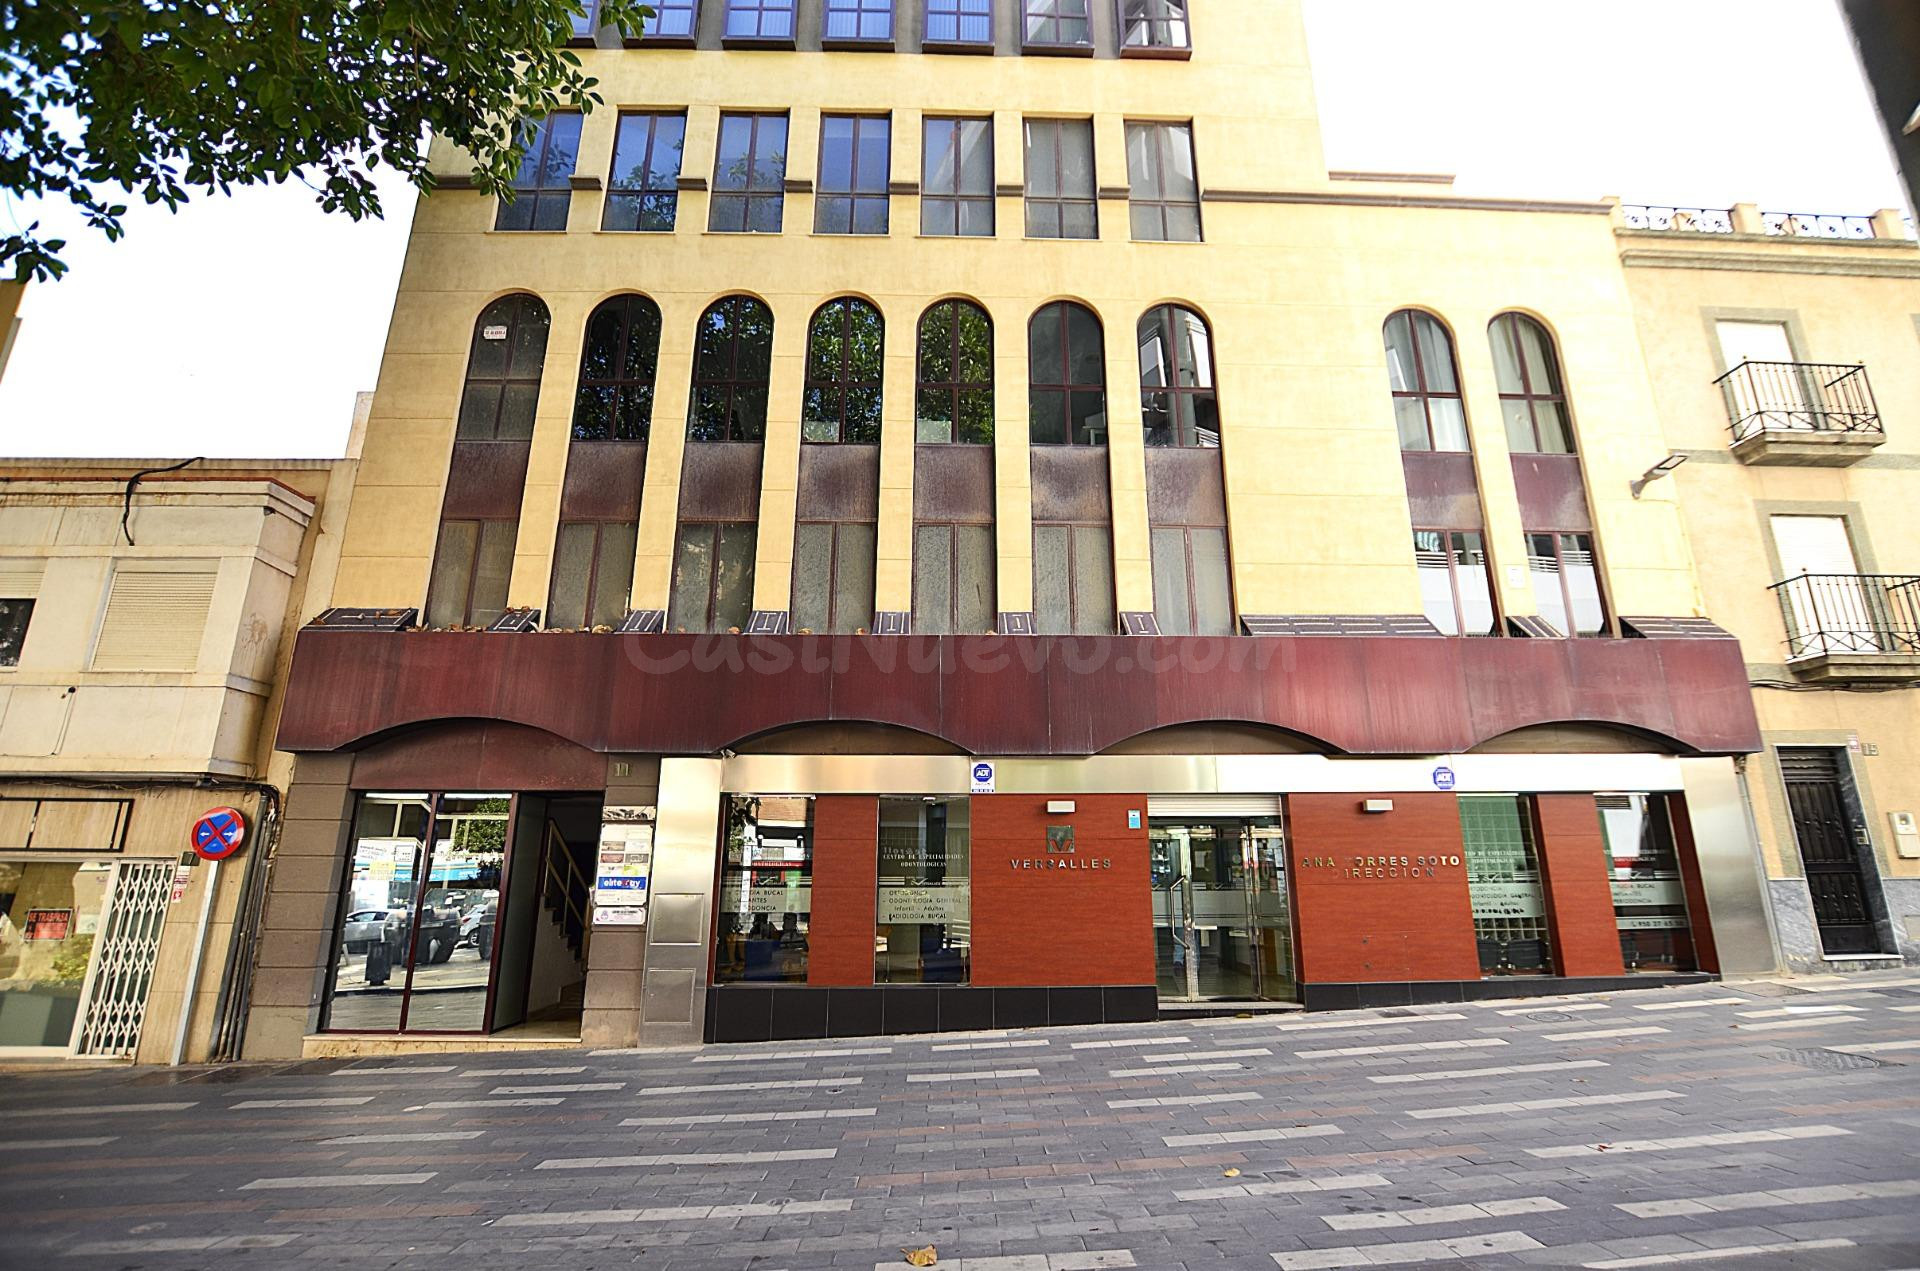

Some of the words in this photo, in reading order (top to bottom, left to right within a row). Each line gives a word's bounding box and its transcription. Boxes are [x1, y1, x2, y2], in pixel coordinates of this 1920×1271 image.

[1011, 859, 1112, 869] VERSALLES
[1302, 857, 1336, 867] ANA
[1345, 856, 1409, 867] ORRES
[1417, 856, 1461, 866] SOTO
